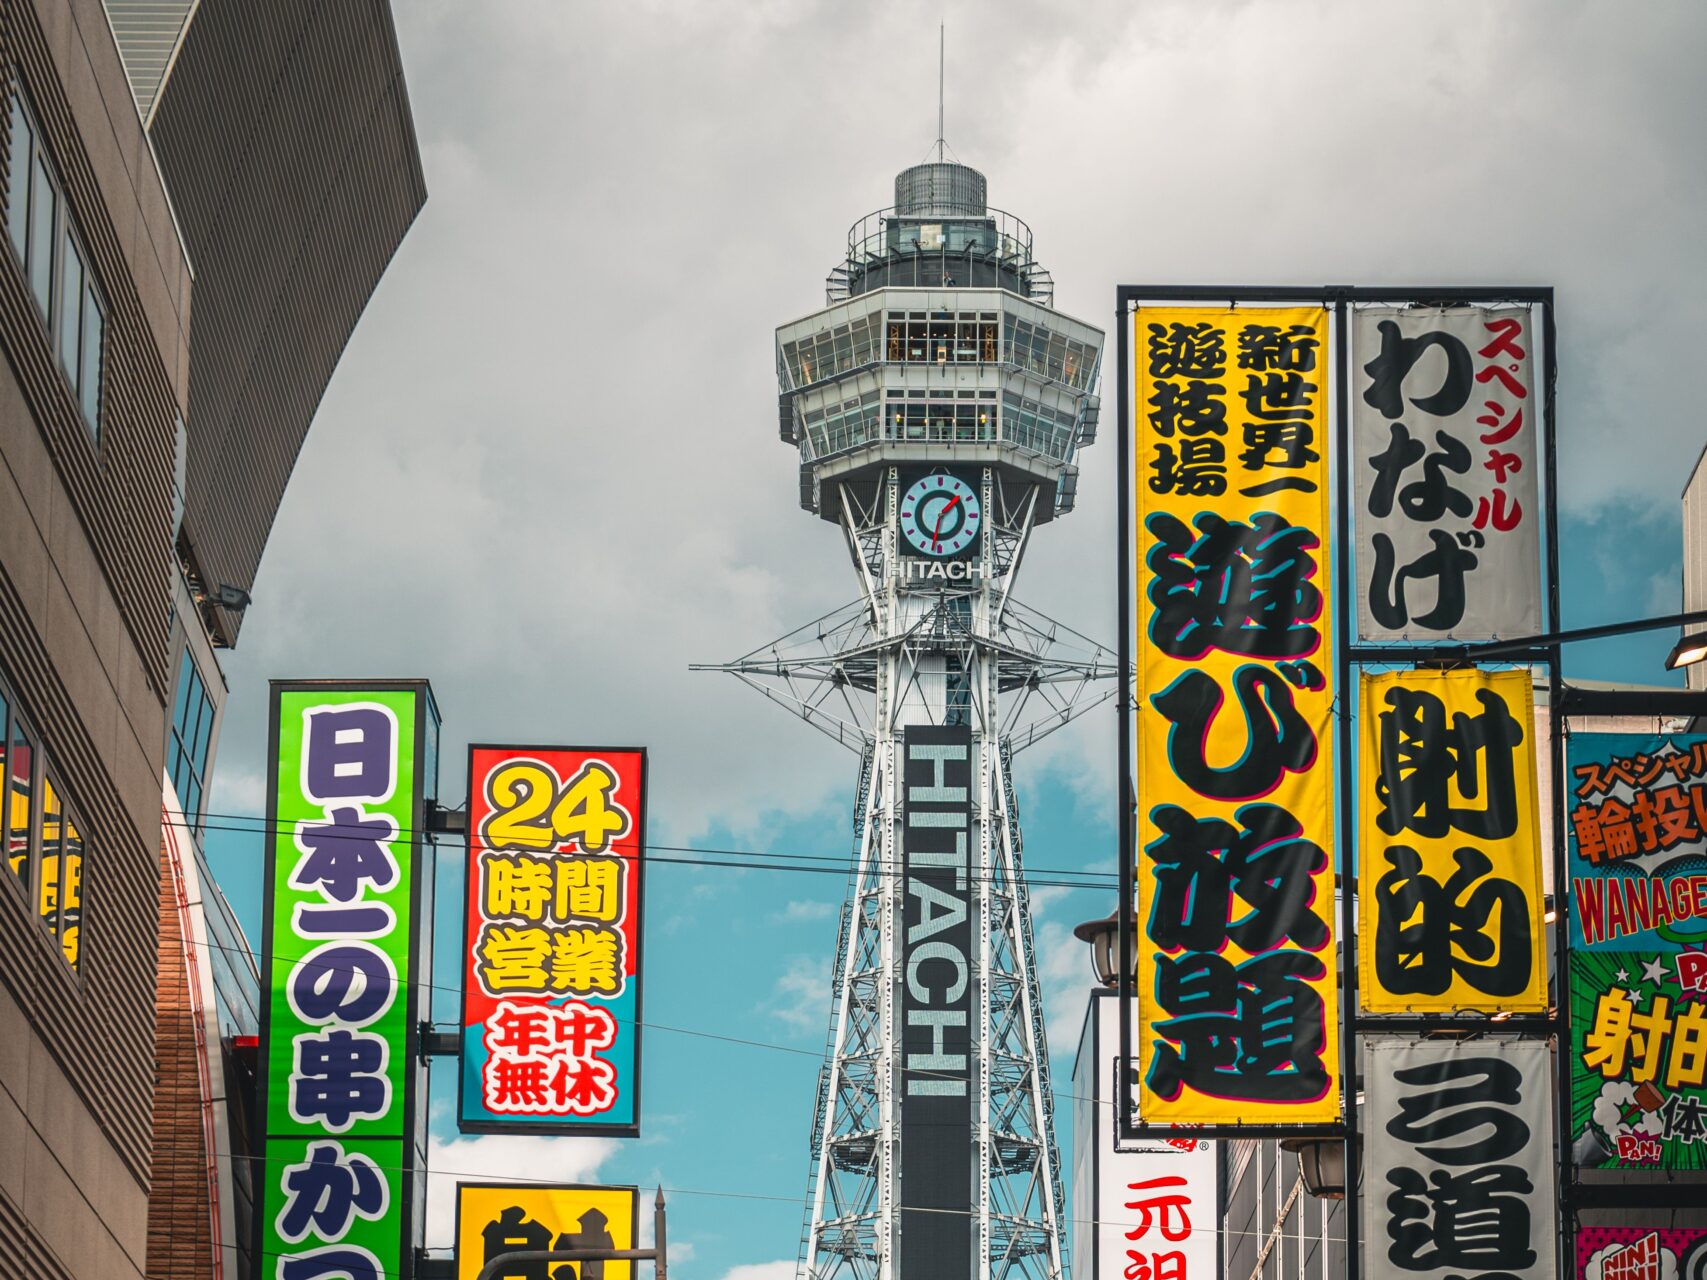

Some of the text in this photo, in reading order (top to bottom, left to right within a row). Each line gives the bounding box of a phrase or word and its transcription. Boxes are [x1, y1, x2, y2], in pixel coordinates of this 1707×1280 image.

[1147, 322, 1229, 498] 遊技場
[1236, 324, 1318, 497] 新世界一
[1362, 319, 1485, 630] わなげ
[1472, 317, 1527, 532] スペシャル
[887, 561, 993, 580] HITACHI
[482, 760, 628, 854] 24
[482, 855, 624, 924] 時間
[1145, 510, 1332, 1106] 遊び放題
[1376, 686, 1534, 997] 射的
[479, 926, 622, 995] 営業
[906, 743, 968, 1097] HITACHI
[490, 1057, 609, 1109] 無休
[493, 1007, 608, 1058] 年中
